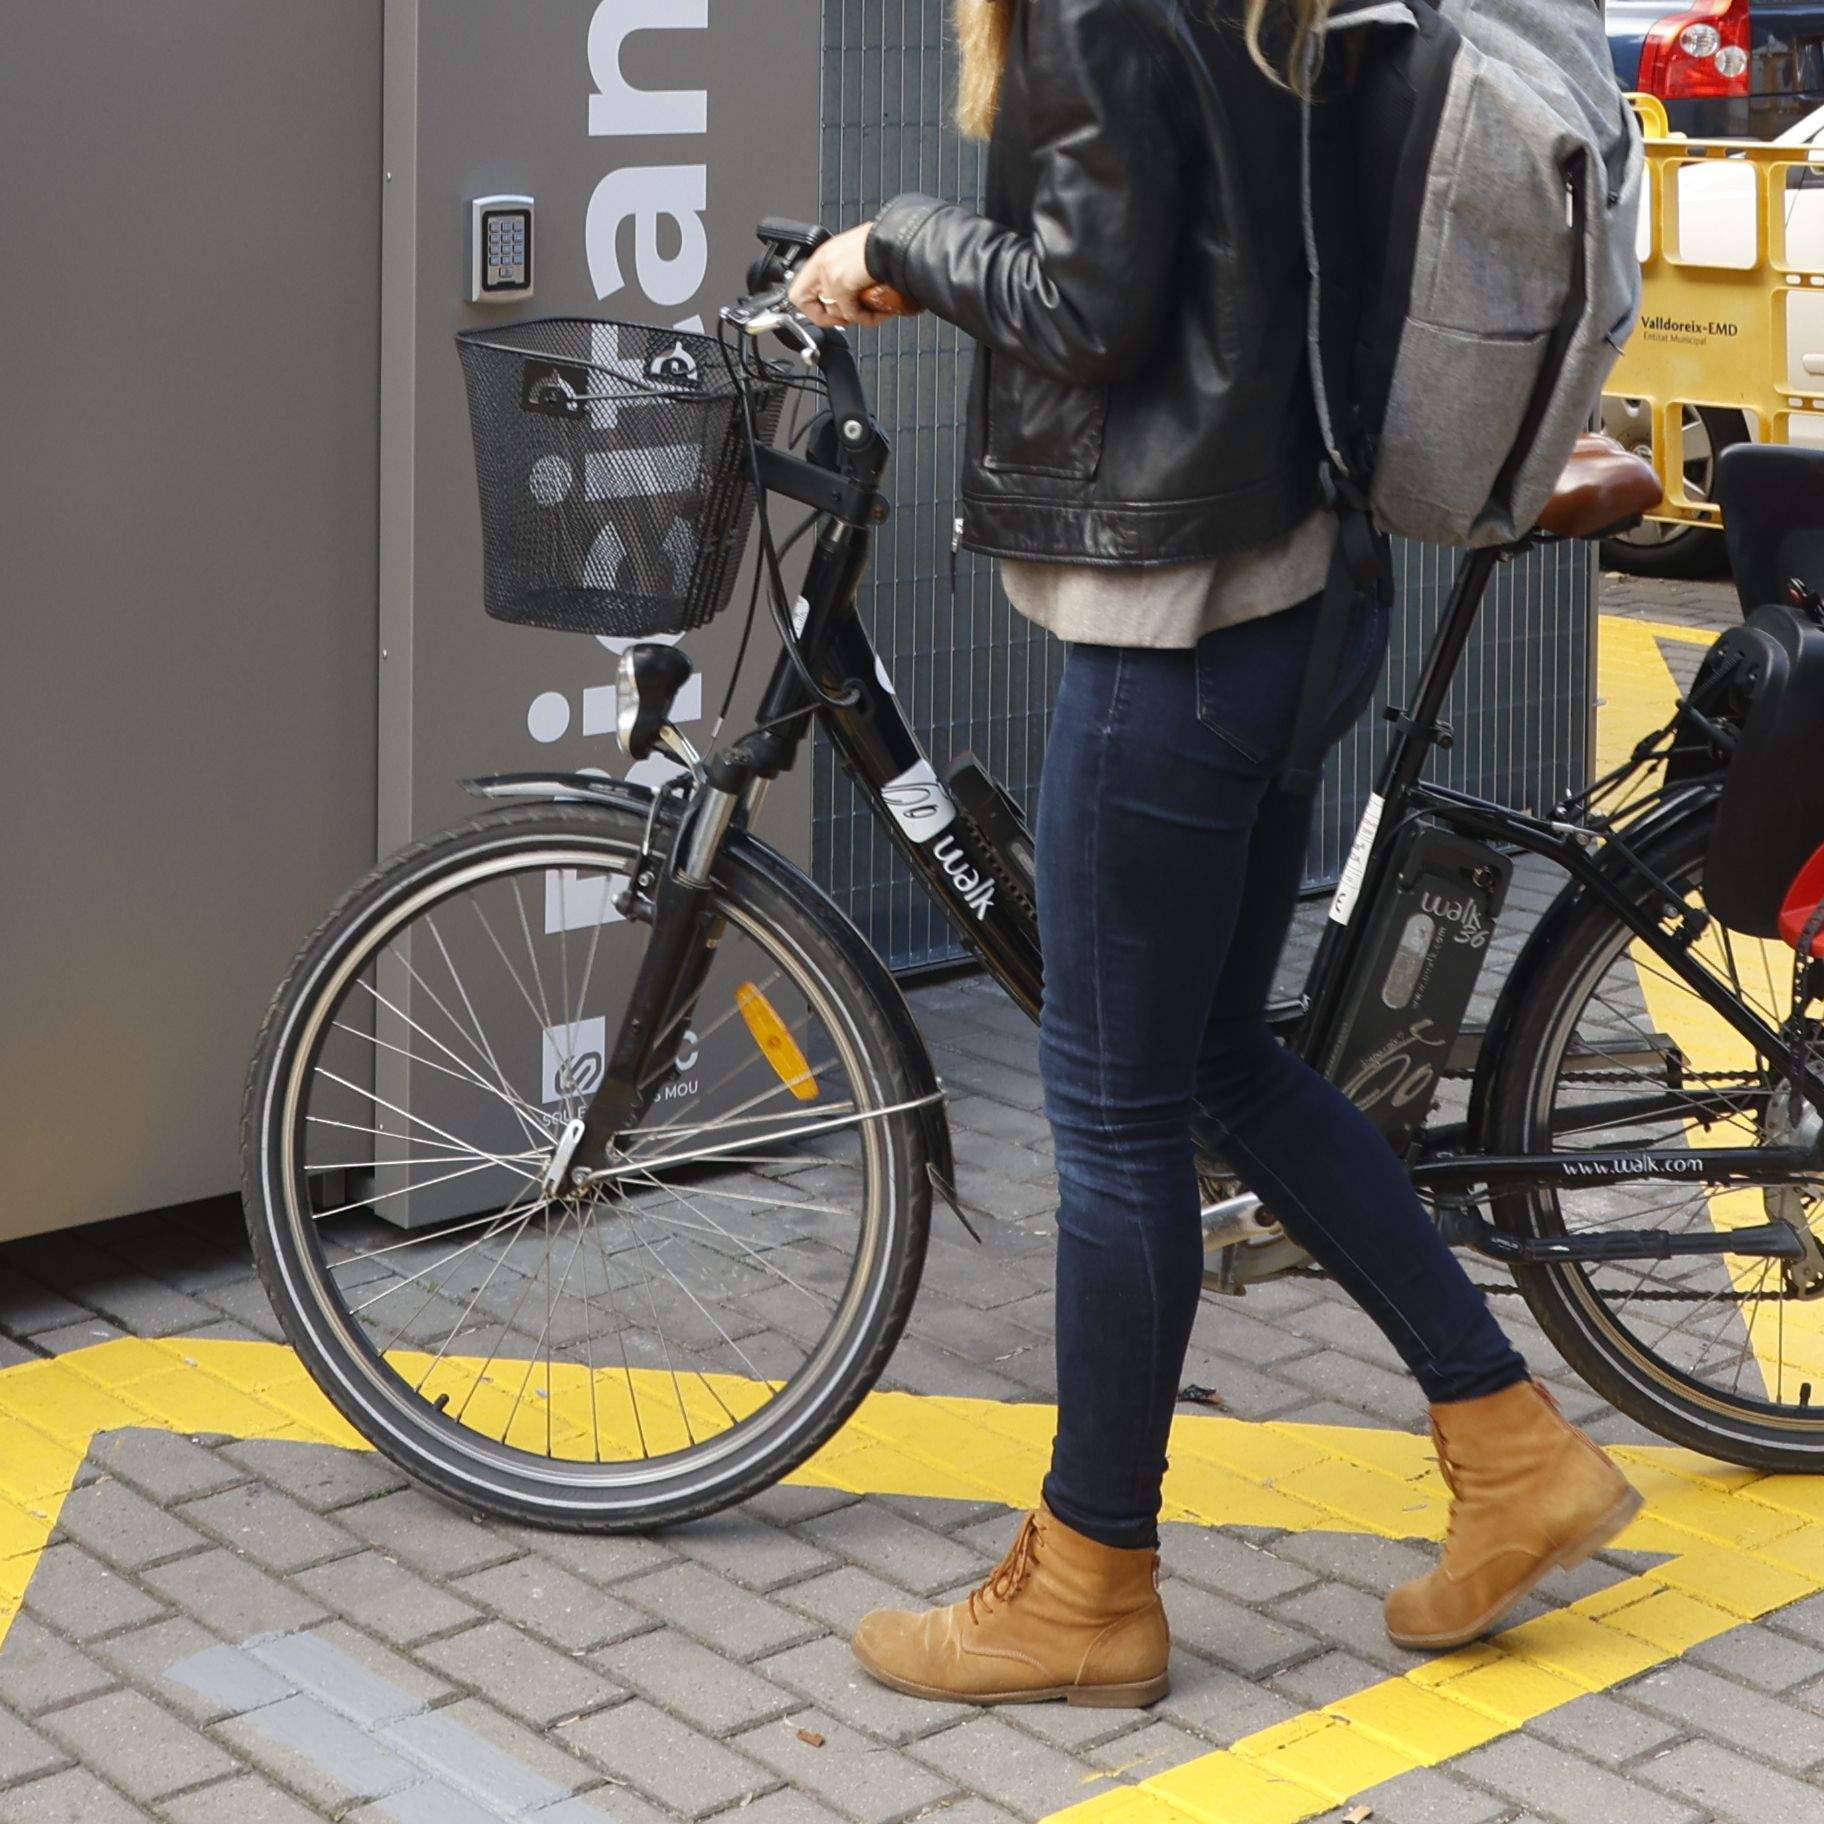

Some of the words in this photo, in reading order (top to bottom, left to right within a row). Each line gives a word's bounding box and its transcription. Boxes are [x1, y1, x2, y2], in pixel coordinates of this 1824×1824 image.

[1641, 316, 1738, 337] Valldoreix-EMD
[1643, 332, 1668, 344] Entitat
[1670, 334, 1707, 346] Municipal
[665, 1081, 698, 1101] MOU
